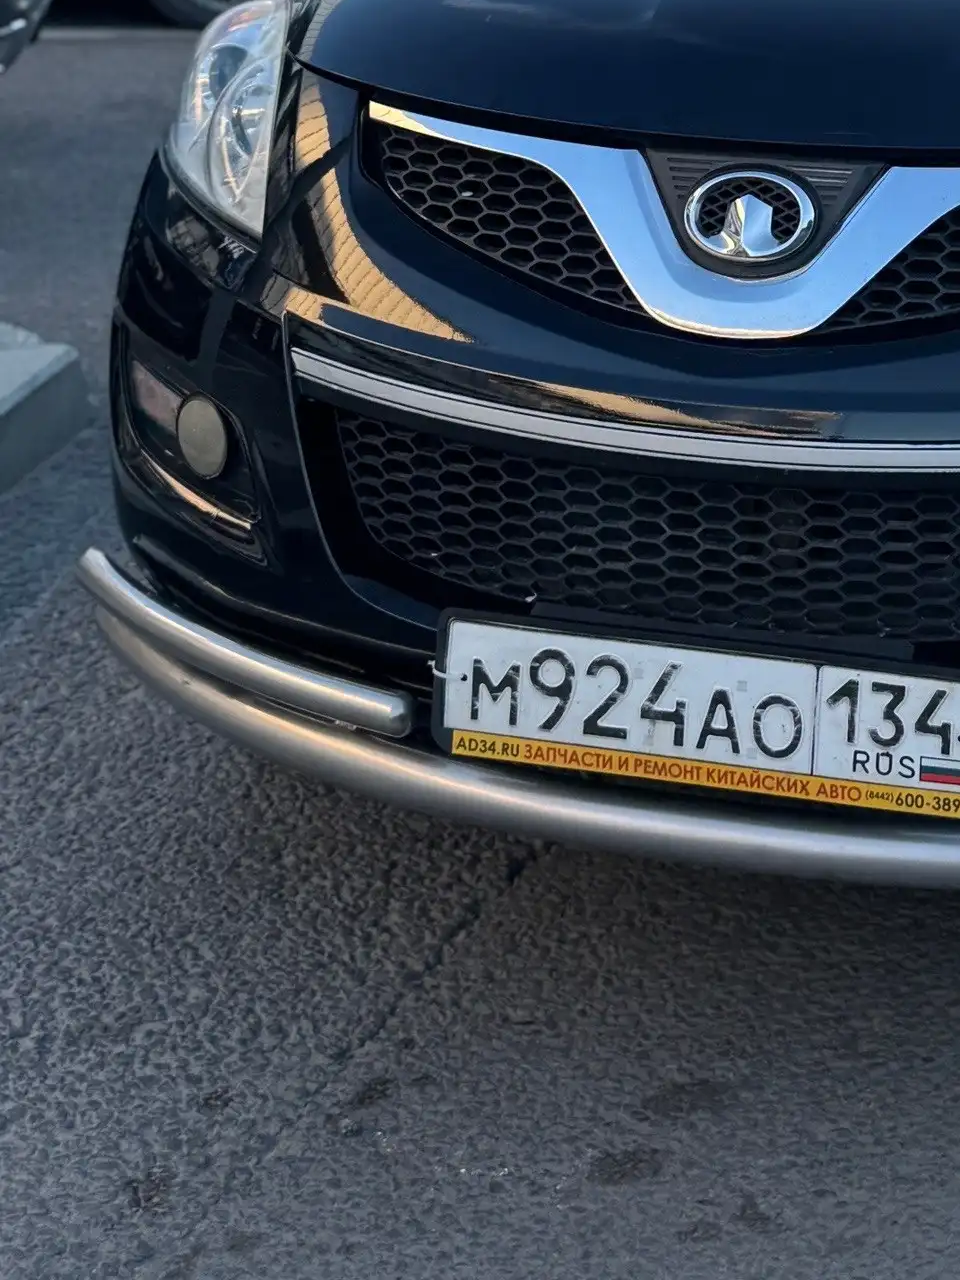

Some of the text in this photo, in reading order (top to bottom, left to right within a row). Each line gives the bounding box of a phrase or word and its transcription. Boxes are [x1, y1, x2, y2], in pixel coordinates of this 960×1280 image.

[826, 678, 952, 756] 134
[455, 736, 521, 758] AD34.RU
[523, 744, 614, 771] ЗАПЧАСТИ
[618, 756, 630, 772] И
[634, 759, 701, 781] РЕМОНТ
[706, 767, 811, 796] КИТАЙСКИХ
[816, 783, 863, 803] АВТО
[852, 750, 916, 779] RUS
